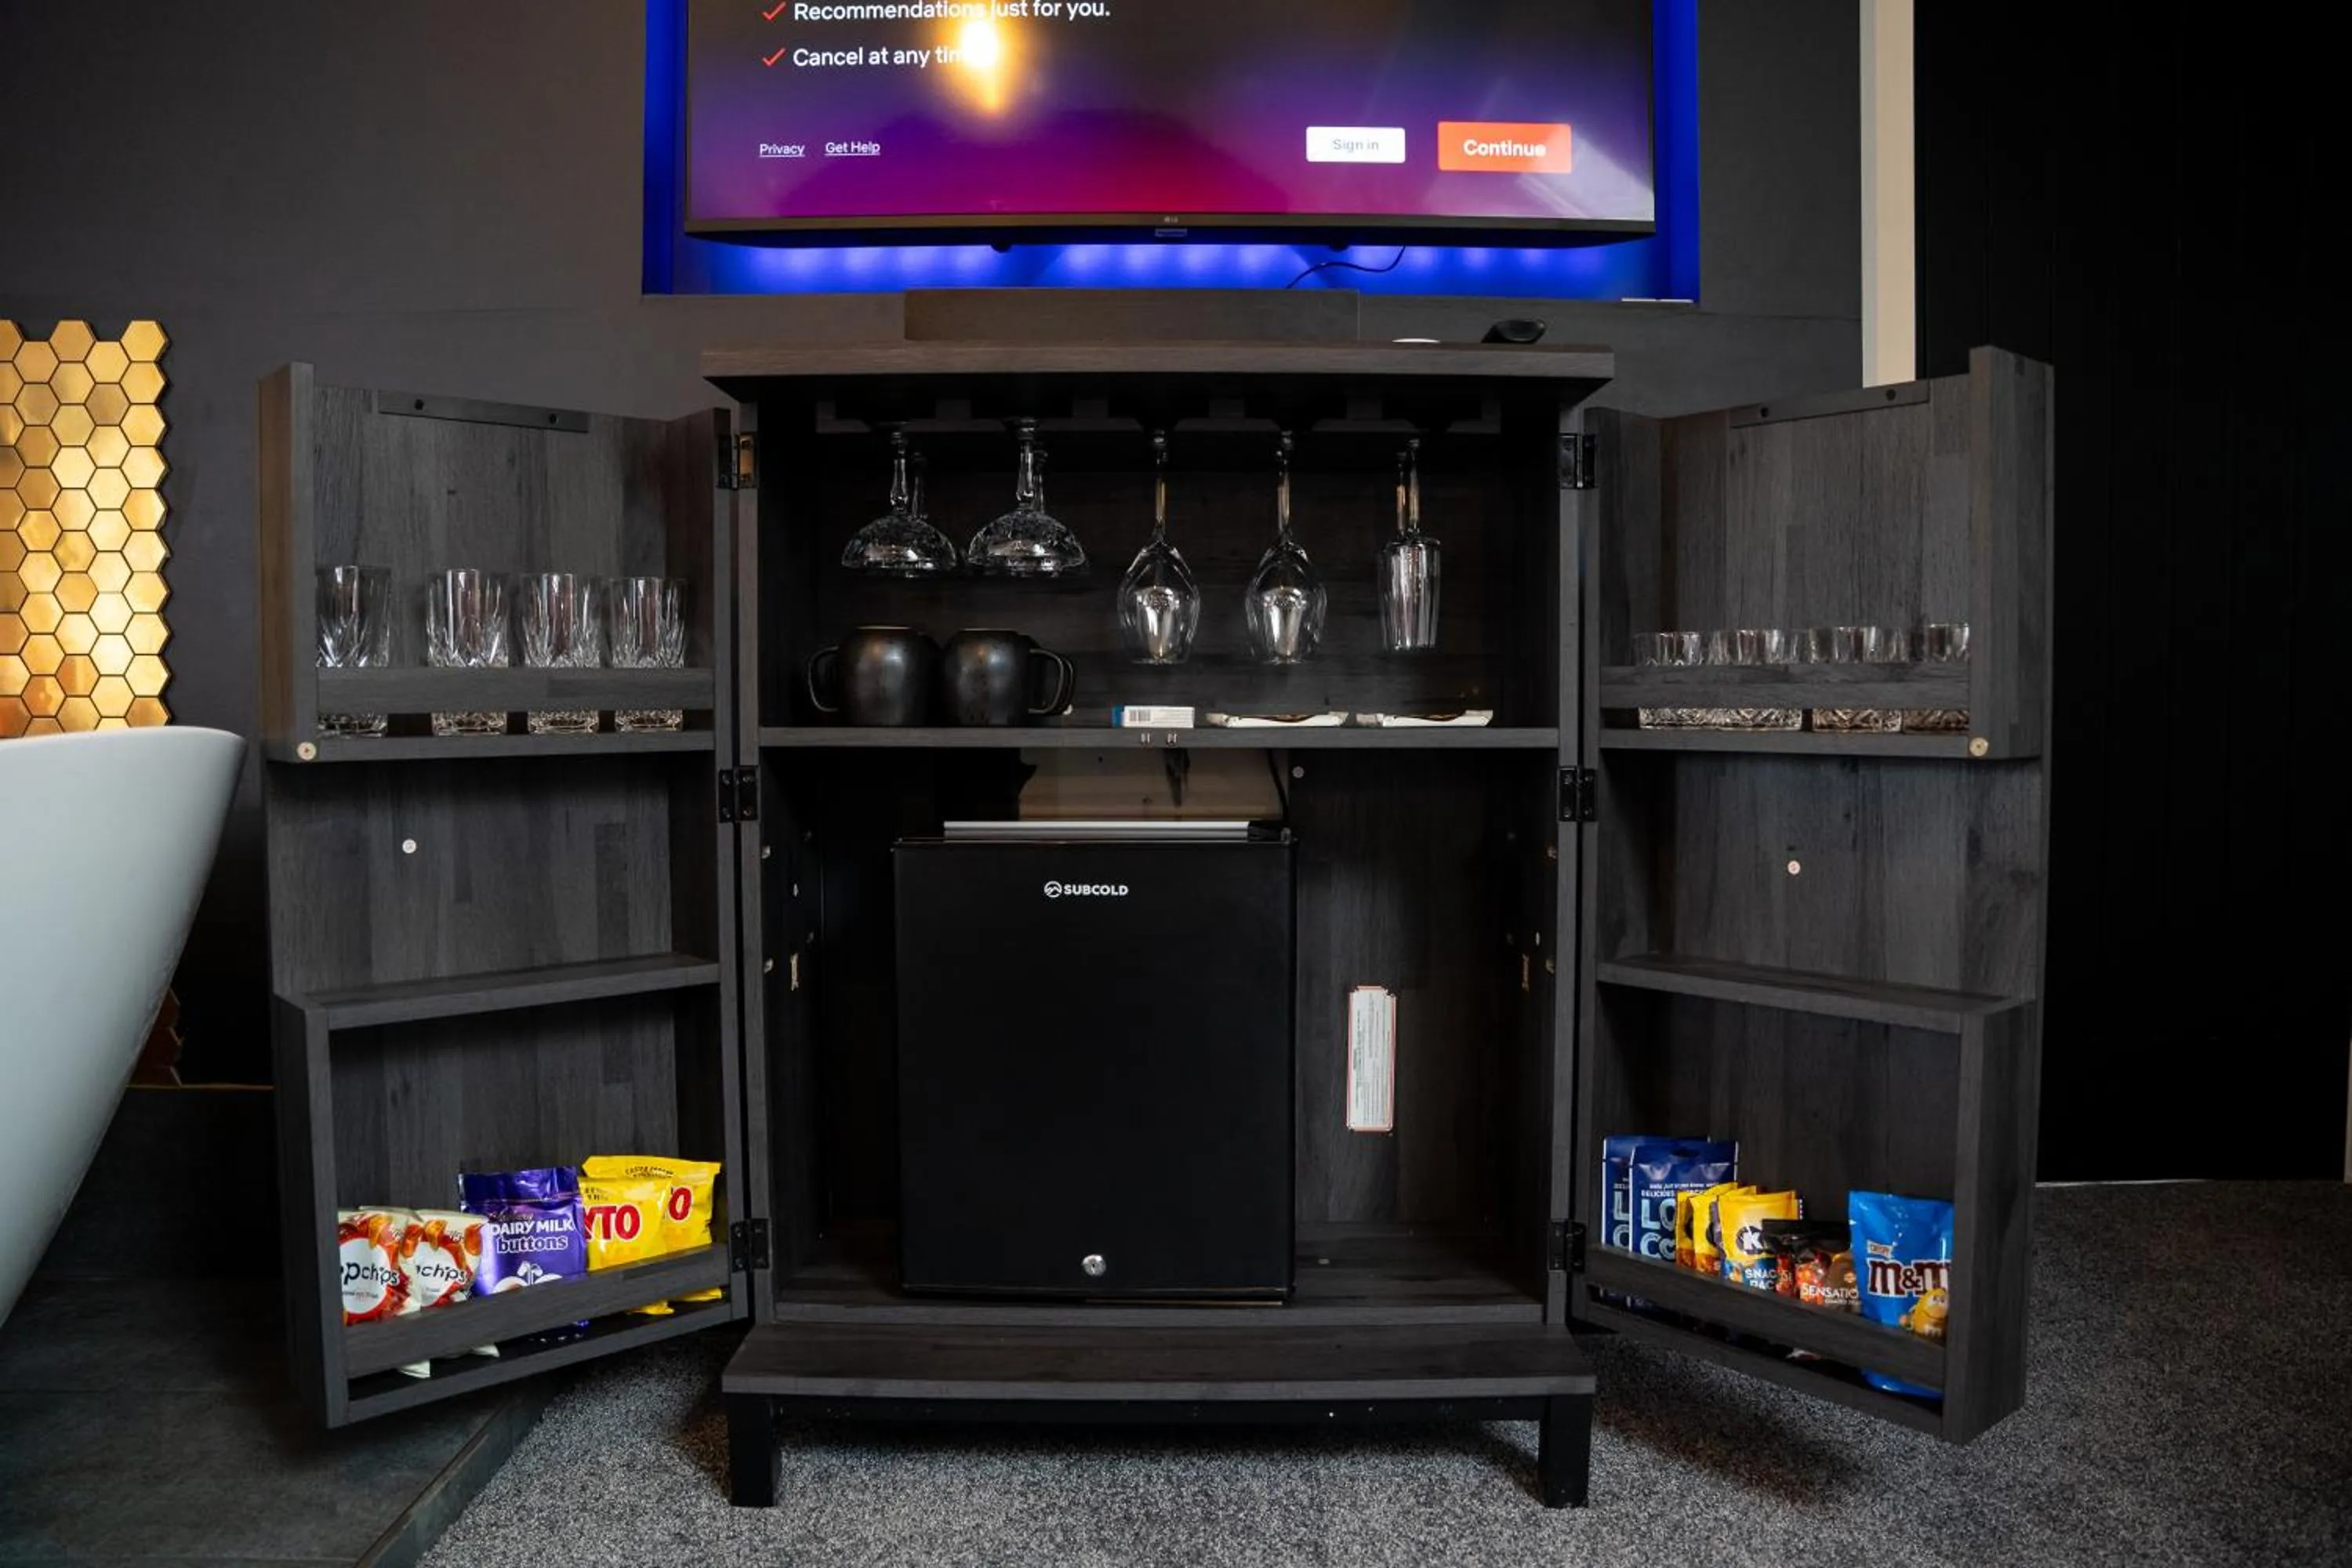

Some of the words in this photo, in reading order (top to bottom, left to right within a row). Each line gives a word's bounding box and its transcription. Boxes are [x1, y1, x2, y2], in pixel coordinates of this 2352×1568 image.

[794, 1, 986, 20] Recommendations
[989, 1, 1028, 20] just
[1033, 1, 1062, 17] for
[1067, 2, 1110, 21] you.
[793, 47, 863, 67] Cancel
[868, 46, 888, 66] at
[893, 49, 931, 69] any
[935, 45, 975, 64] ti
[760, 143, 805, 157] Privacy
[826, 142, 848, 154] Get
[851, 141, 880, 155] Help
[1332, 139, 1362, 152] Sign
[1367, 139, 1379, 151] in
[1463, 139, 1546, 158] Continue
[1064, 884, 1129, 895] SUBCOLD
[668, 1186, 691, 1221] O
[492, 1221, 535, 1236] DAIRY
[536, 1218, 575, 1233] MILK
[497, 1236, 568, 1254] buttons
[340, 1262, 398, 1286] pchips
[416, 1263, 466, 1282] chips
